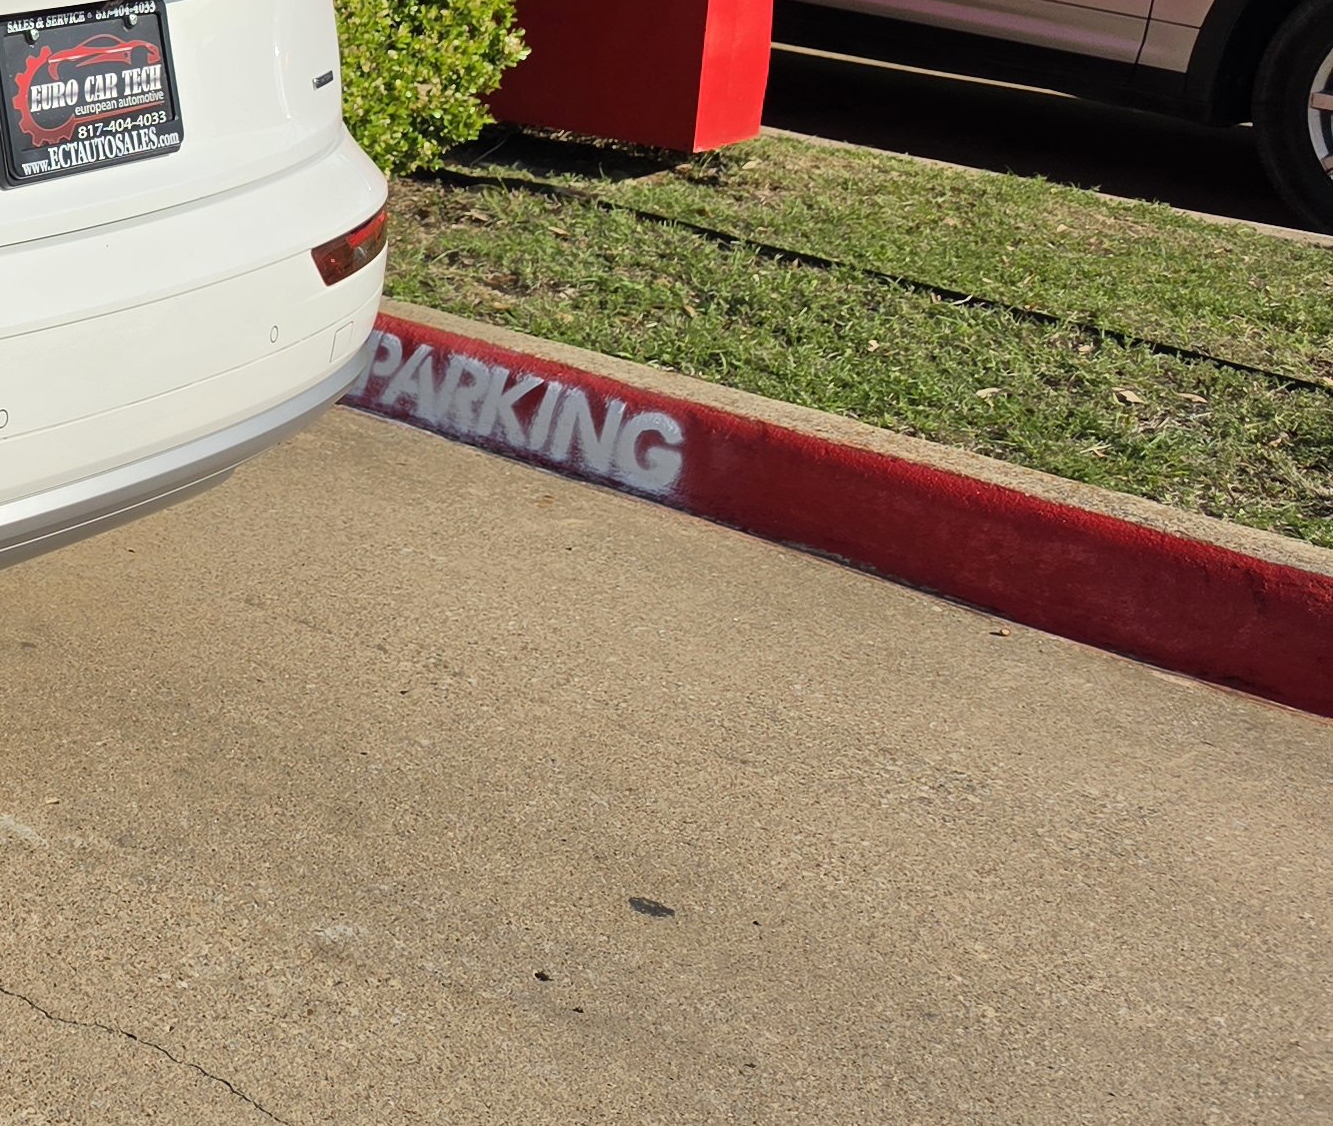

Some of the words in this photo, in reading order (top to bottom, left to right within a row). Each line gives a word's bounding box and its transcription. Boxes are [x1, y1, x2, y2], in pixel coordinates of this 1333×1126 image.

[7, 18, 35, 33] SALES
[46, 11, 86, 28] SERVICE
[30, 79, 79, 113] EURO
[84, 73, 118, 103] CAR
[121, 64, 162, 96] TECH
[74, 99, 118, 116] european
[118, 90, 164, 108] automotive
[77, 110, 167, 139] 817-404-4033
[21, 126, 180, 176] www.ECTAUTOSALES.com
[346, 329, 685, 494] PARKING
